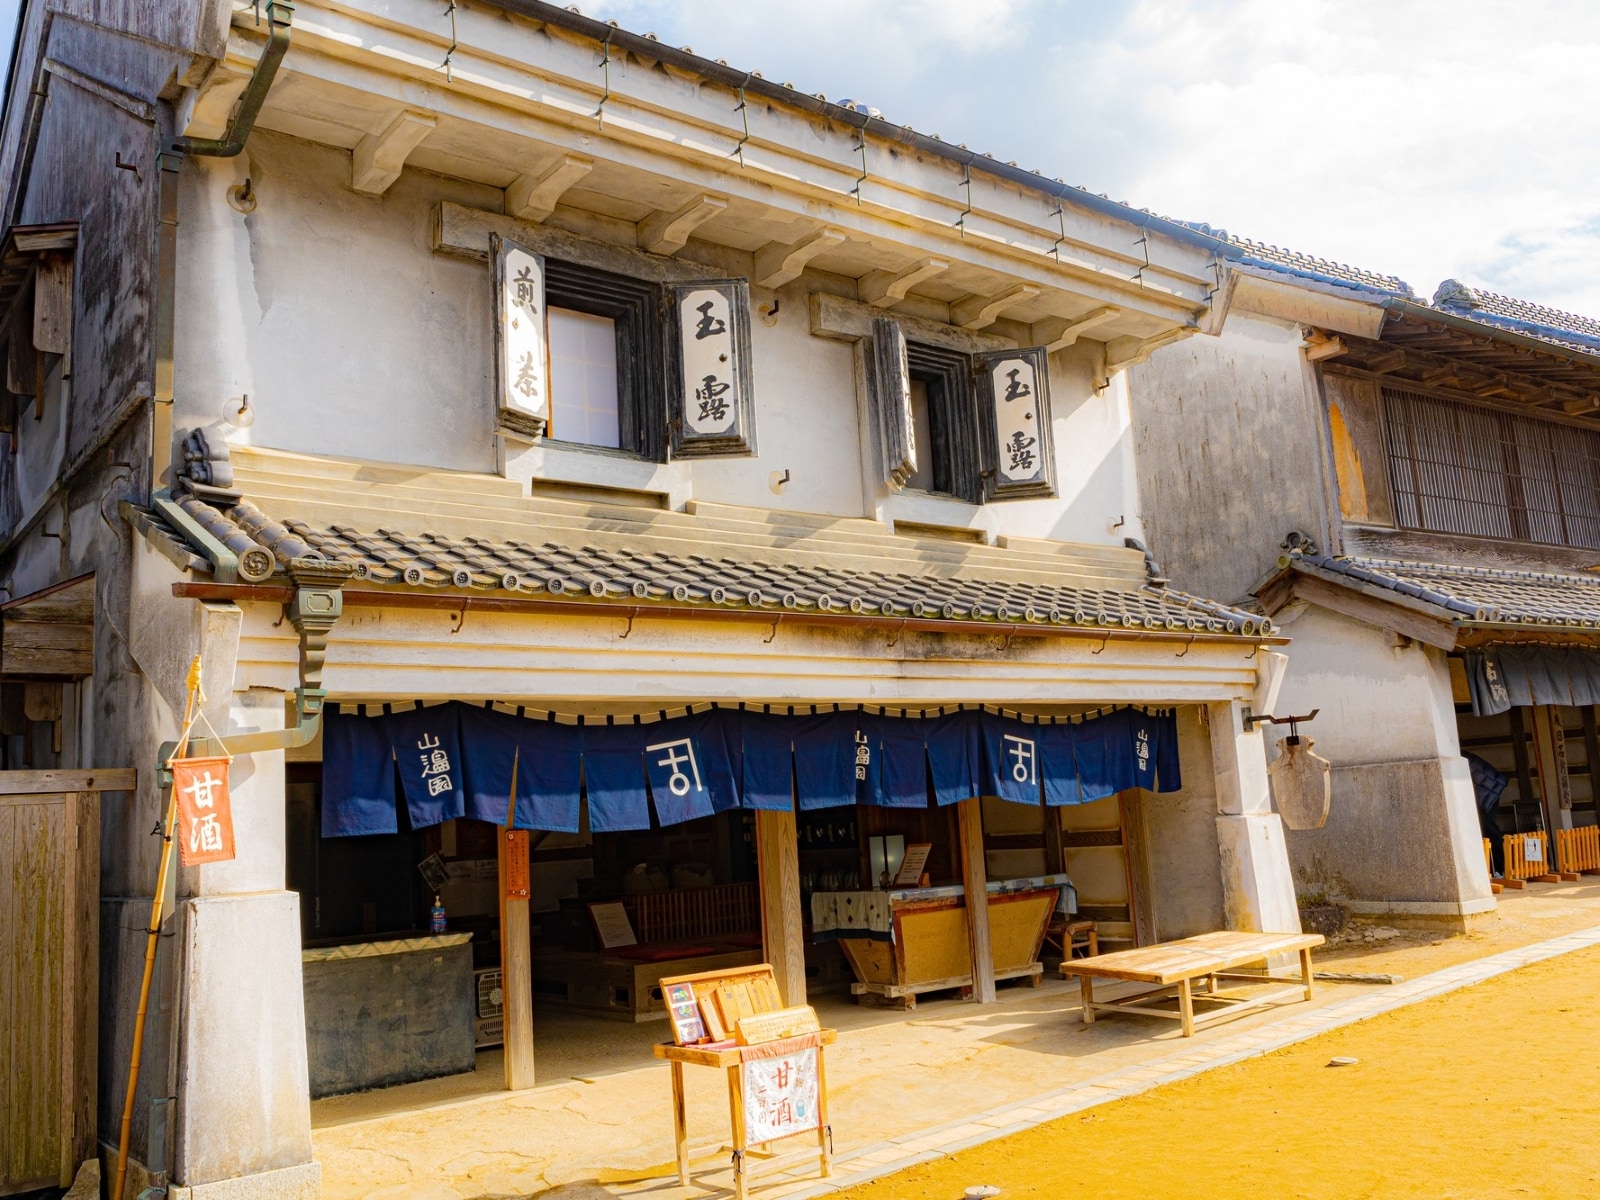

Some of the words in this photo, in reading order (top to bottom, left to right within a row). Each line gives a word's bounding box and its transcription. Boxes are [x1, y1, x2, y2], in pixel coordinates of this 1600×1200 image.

[513, 265, 538, 398] 煎茶
[695, 300, 731, 422] 玉露
[1004, 368, 1037, 472] 玉露
[183, 771, 224, 854] 甘酒
[769, 1060, 795, 1127] 甘酒
